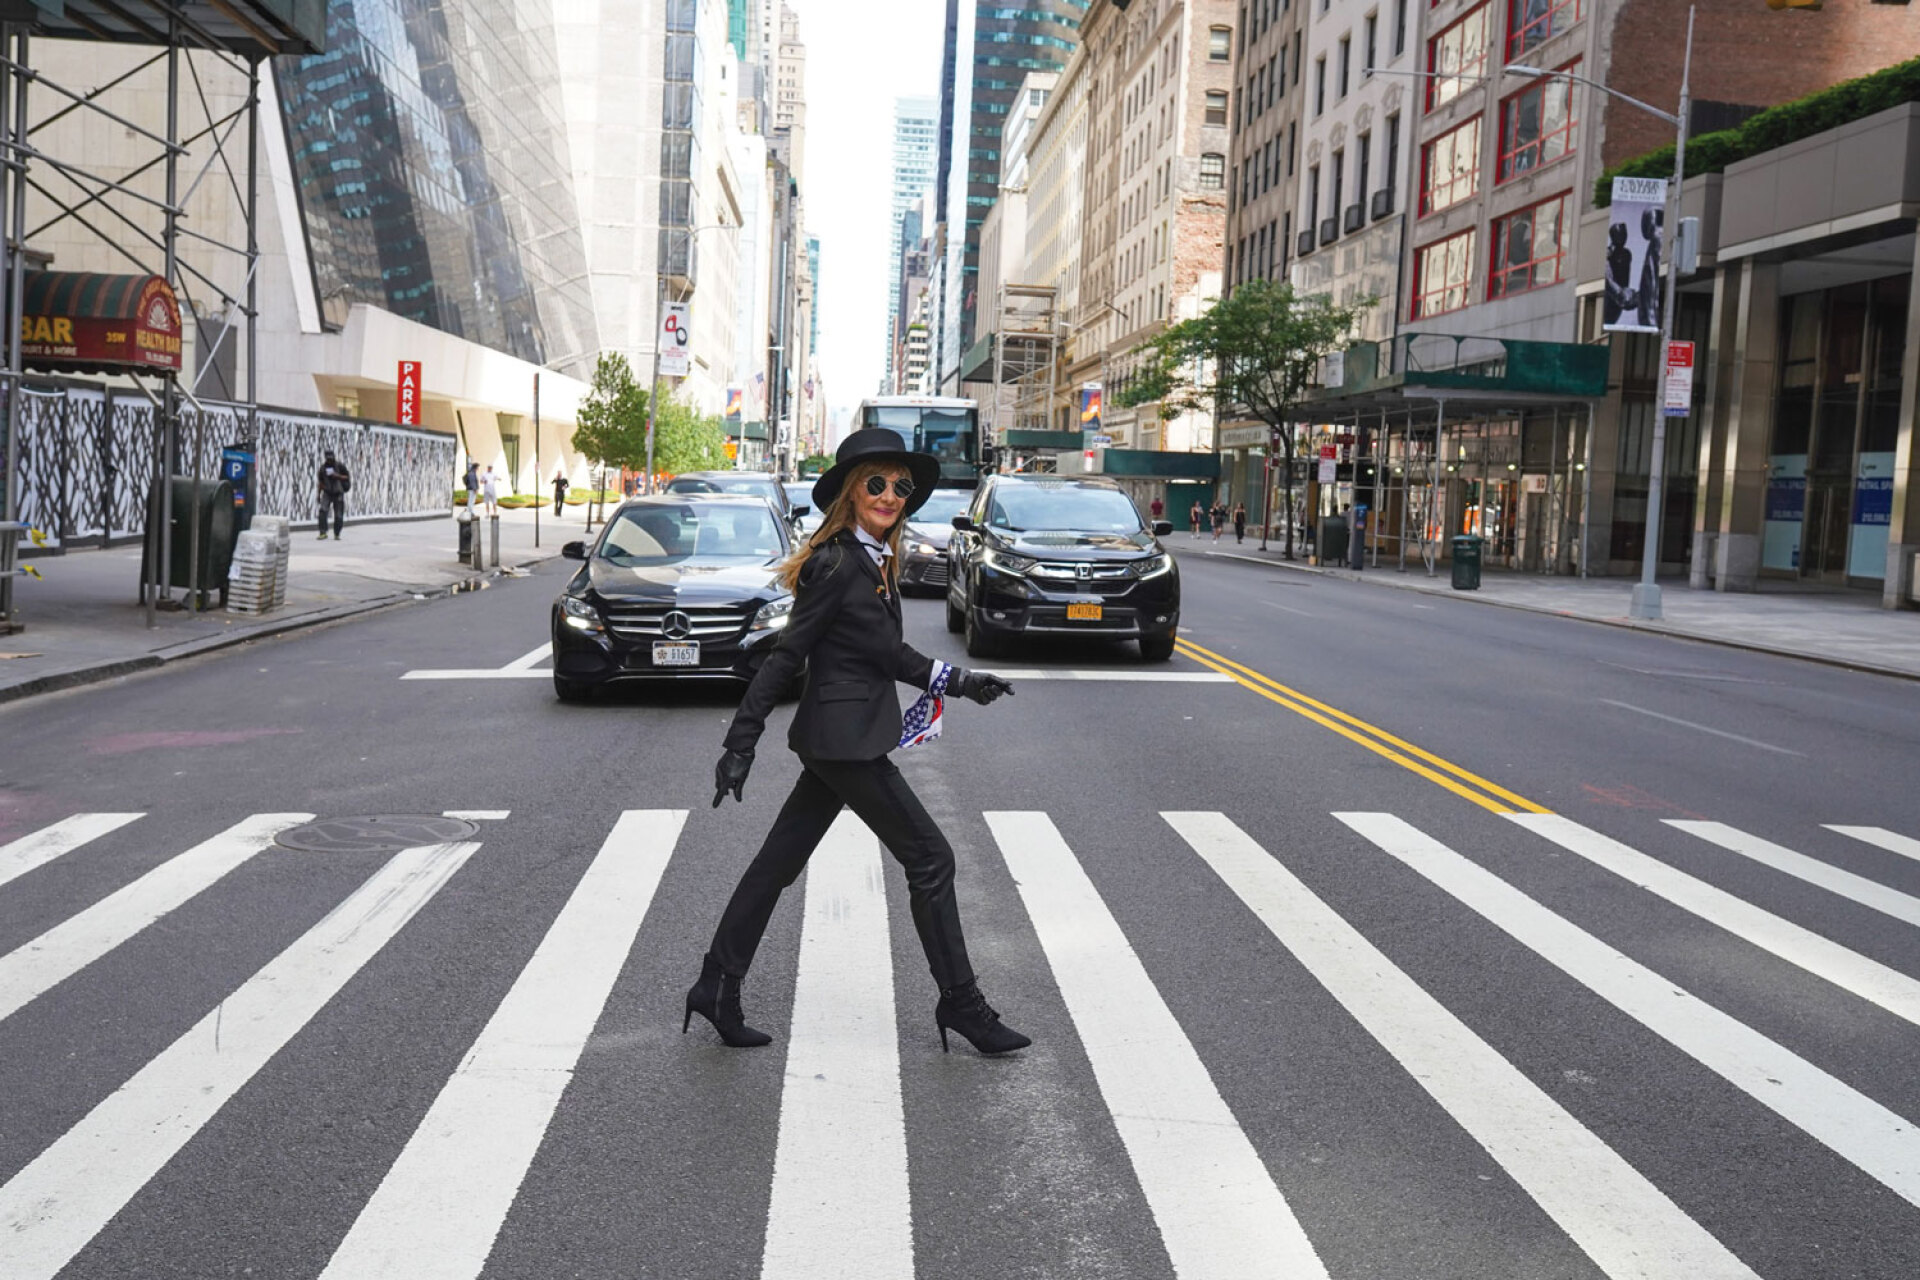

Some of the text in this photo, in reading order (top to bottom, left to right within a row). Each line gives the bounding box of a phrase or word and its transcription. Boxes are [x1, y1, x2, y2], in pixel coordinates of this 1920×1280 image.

[22, 316, 73, 343] BAR
[54, 346, 77, 356] MORE
[232, 462, 242, 478] P
